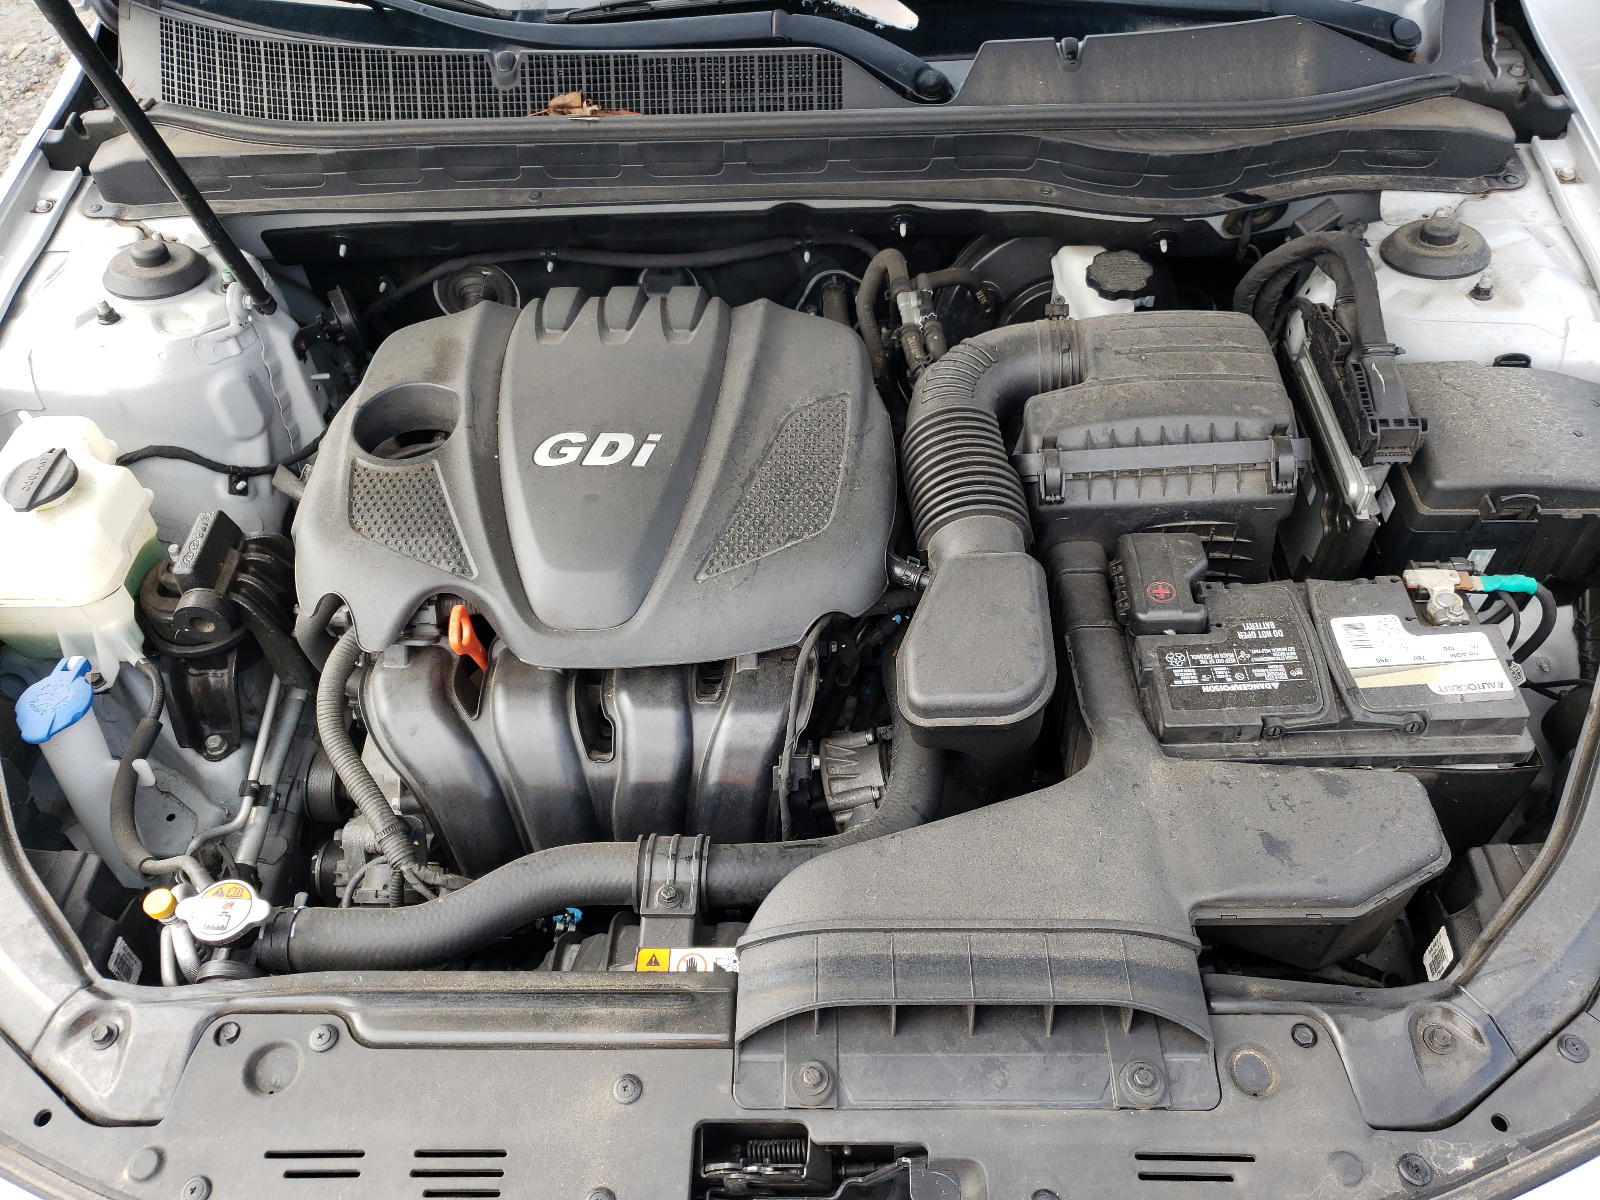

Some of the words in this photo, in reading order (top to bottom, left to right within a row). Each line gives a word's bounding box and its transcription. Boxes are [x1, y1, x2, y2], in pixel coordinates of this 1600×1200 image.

[532, 432, 664, 466] GDi
[1242, 622, 1275, 630] BATTERY!
[1237, 631, 1257, 639] OPEN
[1258, 630, 1272, 638] NOT
[1273, 630, 1284, 638] DO
[1202, 683, 1273, 692] DANGER/POISON
[1438, 682, 1496, 692] AUTOCRAFT
